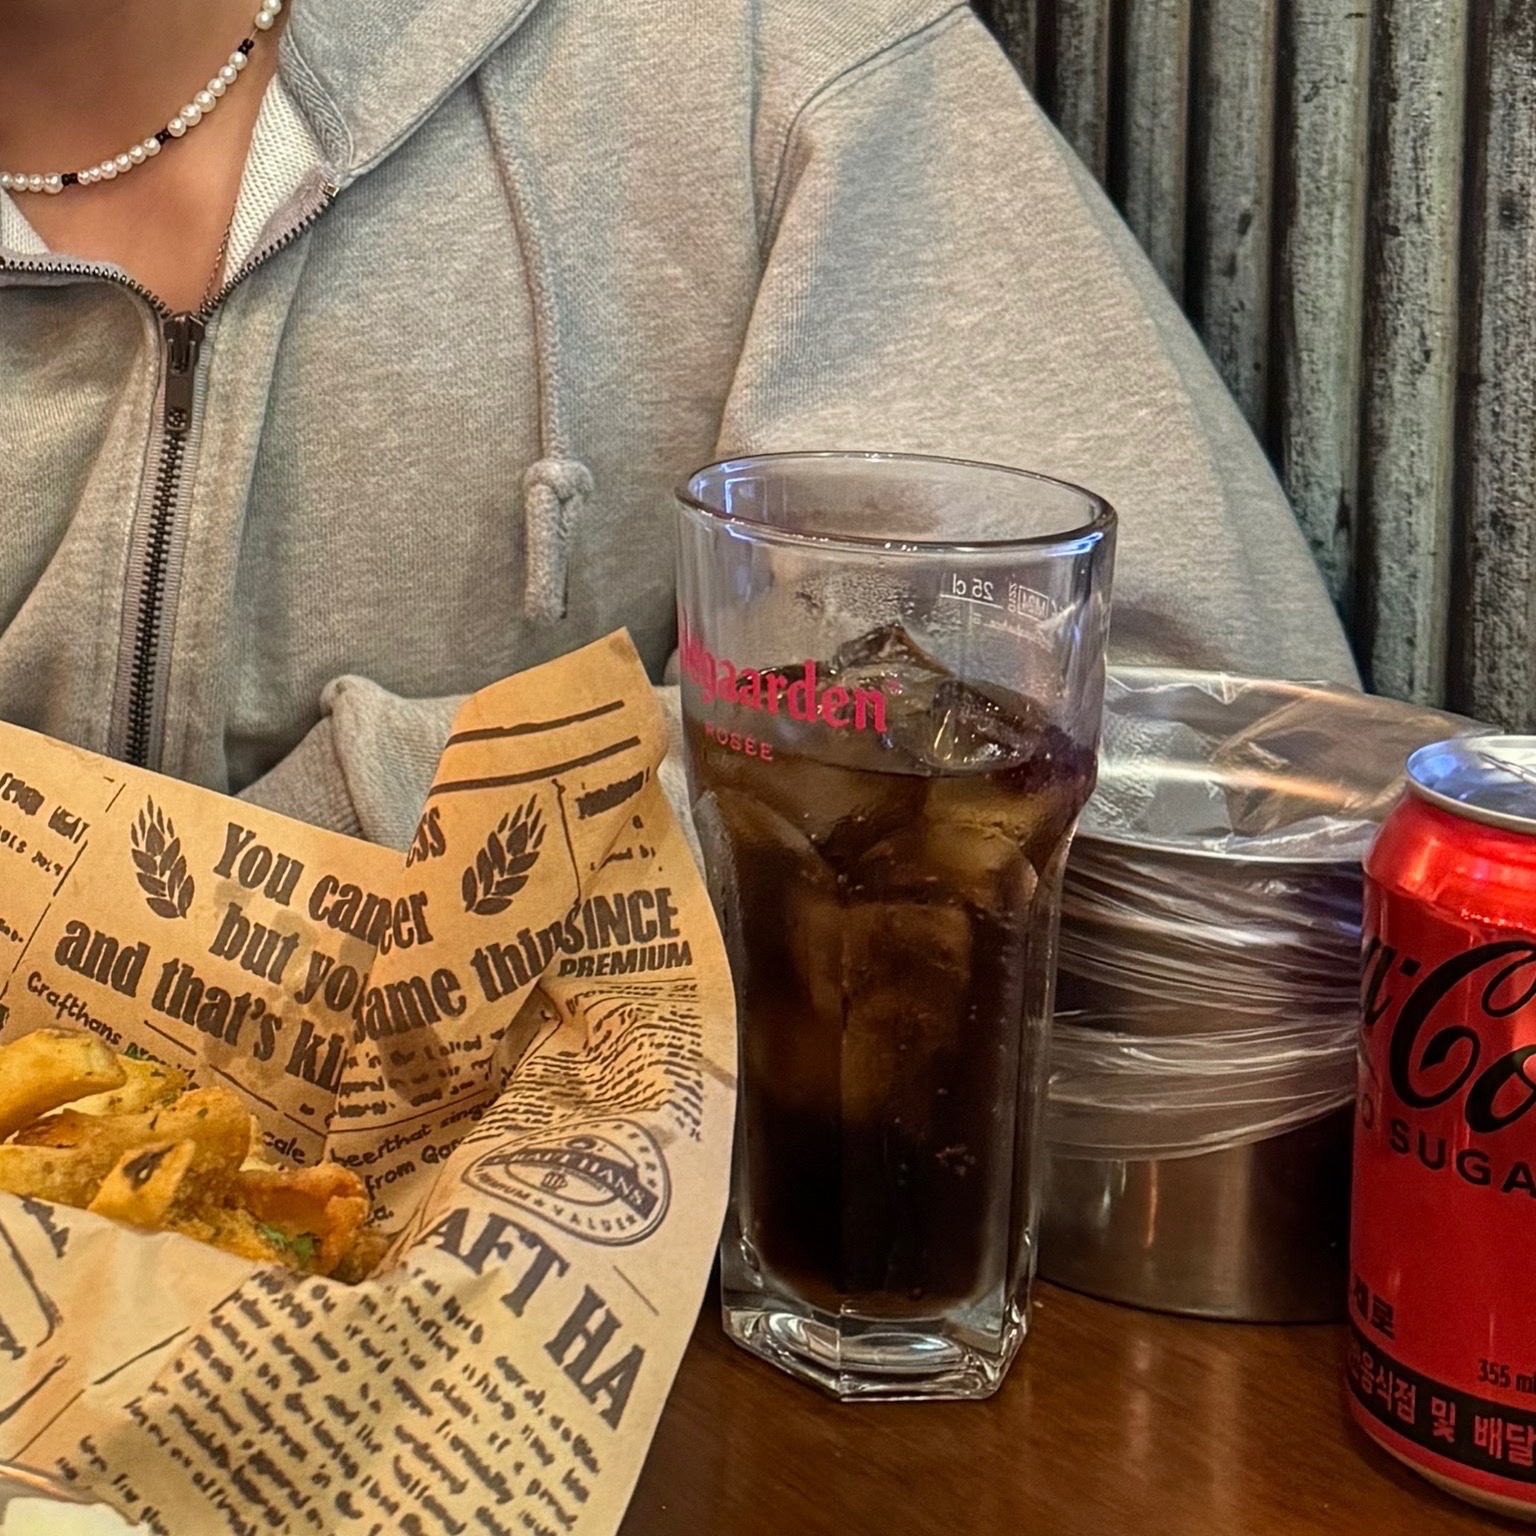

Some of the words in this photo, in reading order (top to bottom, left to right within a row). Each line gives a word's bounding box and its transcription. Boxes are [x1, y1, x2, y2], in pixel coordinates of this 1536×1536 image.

[213, 821, 305, 907] You
[562, 886, 681, 955] SINCE
[54, 919, 151, 998] and
[151, 957, 283, 1062] that's
[208, 901, 300, 985] but
[293, 950, 368, 1020] yo
[557, 939, 694, 978] PREMIUM
[27, 970, 123, 1046] Crafthans
[1478, 1357, 1512, 1390] 355
[1430, 1394, 1457, 1445] 및
